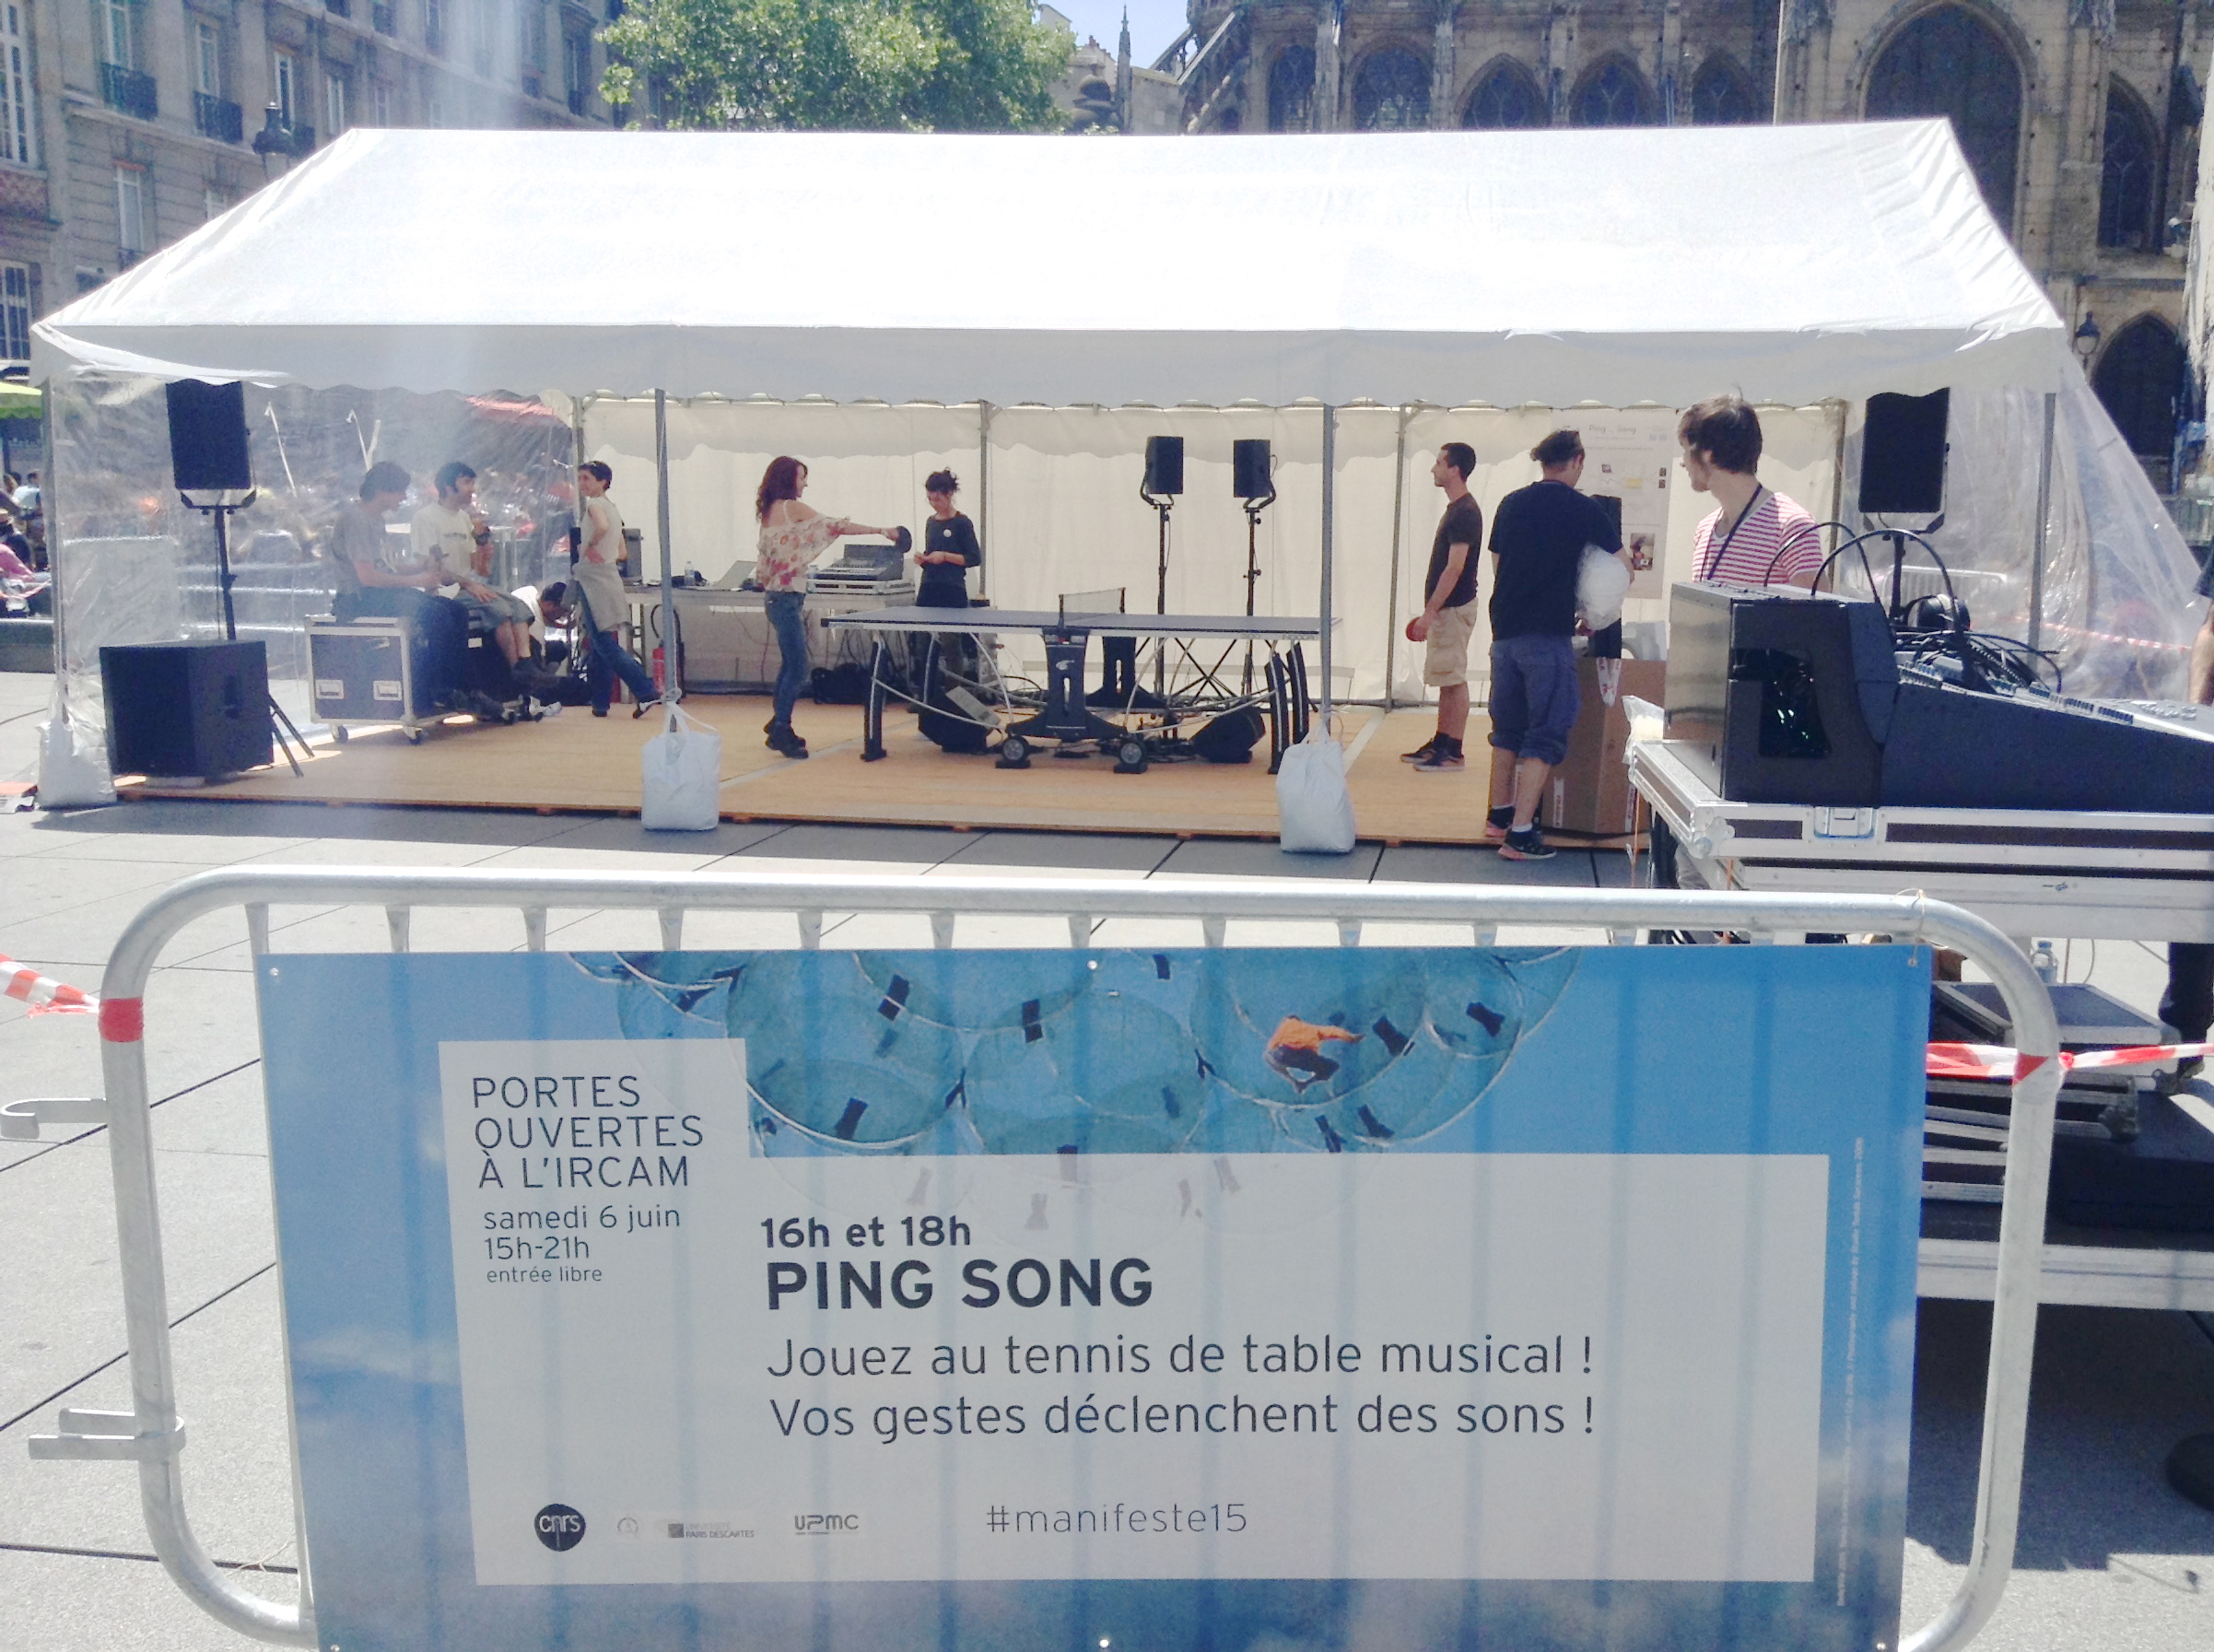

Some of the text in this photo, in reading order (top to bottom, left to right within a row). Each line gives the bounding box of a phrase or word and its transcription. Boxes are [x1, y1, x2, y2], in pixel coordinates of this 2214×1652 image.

[1588, 424, 1607, 433] Ping
[472, 1075, 640, 1109] PORTES
[474, 1114, 703, 1150] OUVERTES
[478, 1149, 688, 1189] À L'IRCAM
[484, 1204, 681, 1233] samedi 6 juin
[760, 1214, 971, 1248] 16h et 18h
[484, 1236, 590, 1260] 15h-21h
[486, 1266, 603, 1283] entrée libre
[767, 1257, 1153, 1311] PING SONG
[767, 1333, 1592, 1377] Jouez au tennis de table musical !
[769, 1392, 1594, 1444] Vos gestes déclenchent des sons !
[685, 1529, 755, 1539] PARIS DESCARTES
[987, 1503, 1247, 1533] #manifeste15
